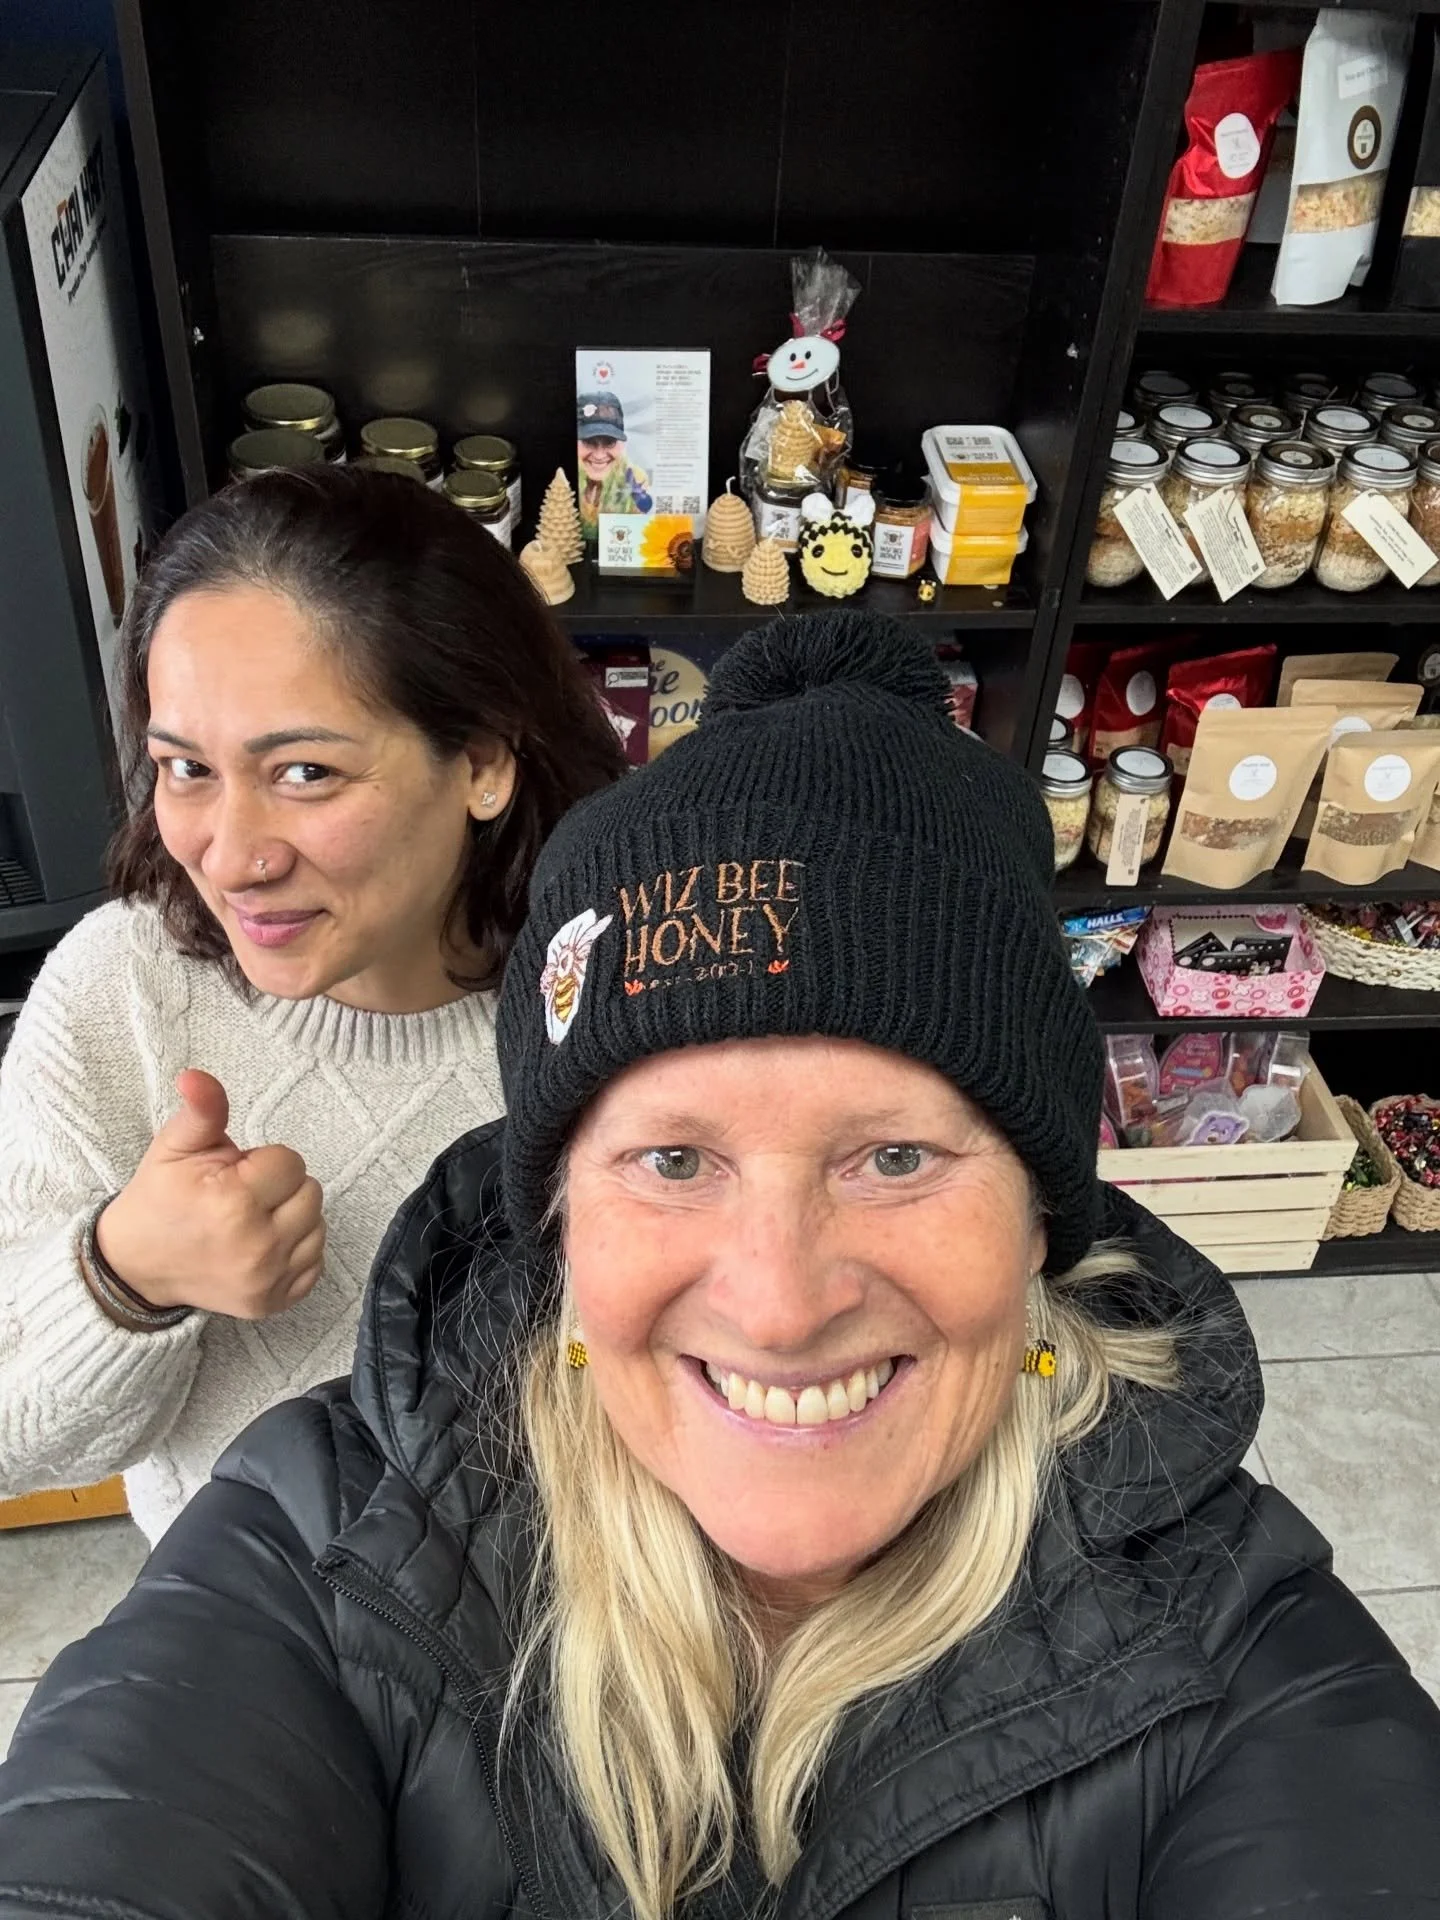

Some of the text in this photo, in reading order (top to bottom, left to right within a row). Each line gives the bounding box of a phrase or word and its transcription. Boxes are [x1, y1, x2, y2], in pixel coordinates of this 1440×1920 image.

[613, 858, 806, 926] WIZ BEE
[1086, 912, 1125, 929] HALLS
[624, 904, 800, 978] HONEY
